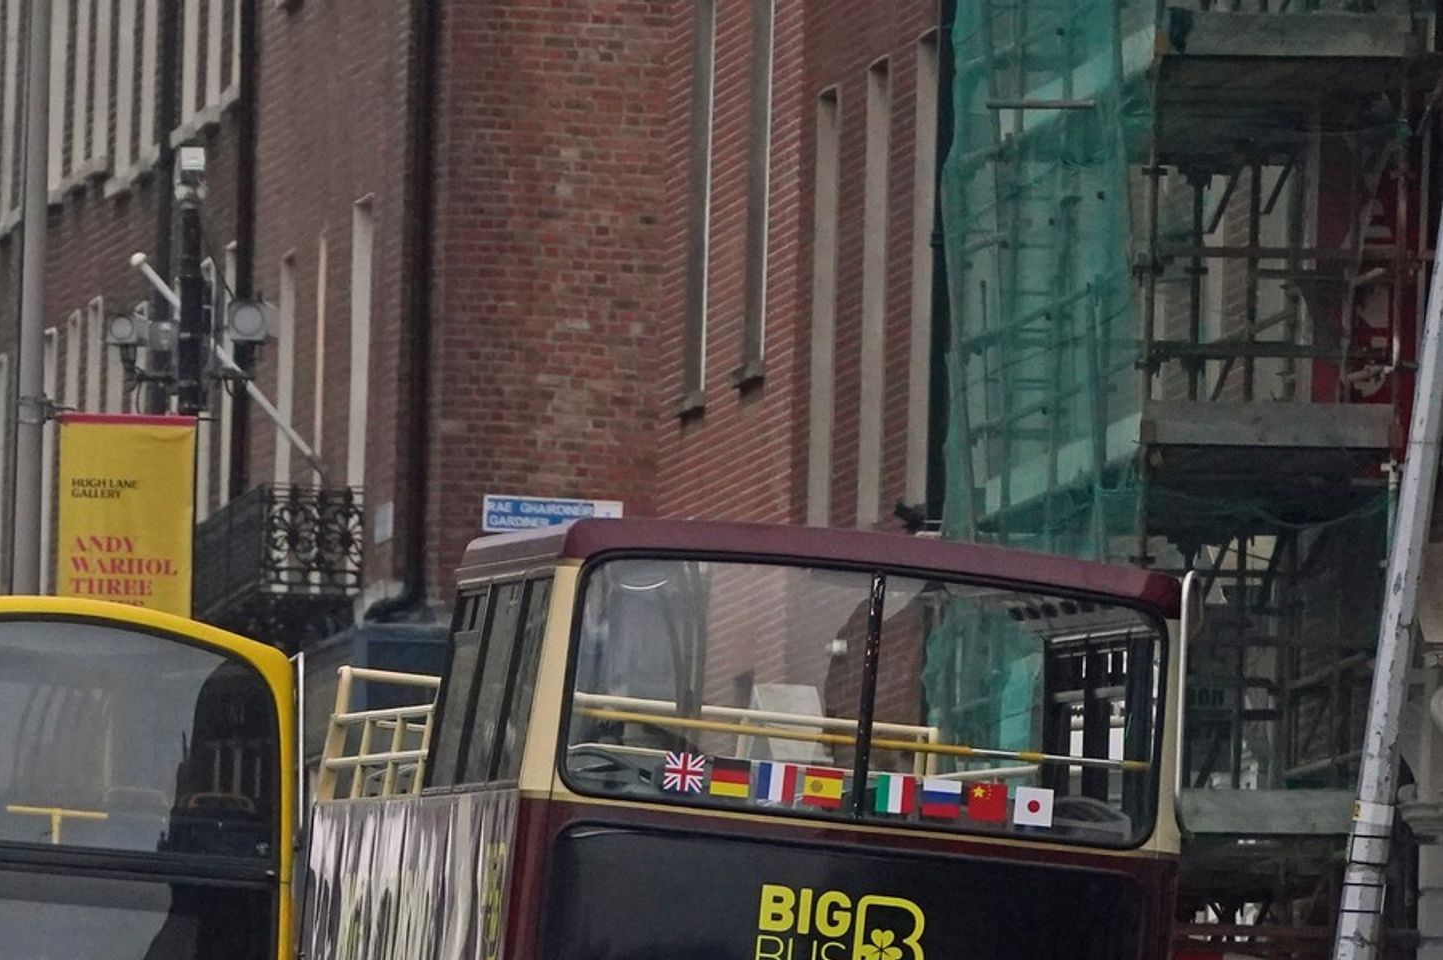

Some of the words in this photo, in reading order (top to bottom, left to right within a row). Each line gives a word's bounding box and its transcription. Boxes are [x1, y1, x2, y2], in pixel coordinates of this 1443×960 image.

[71, 478, 107, 488] HUGH
[109, 479, 138, 489] LANE
[71, 488, 122, 499] GALLERY
[489, 514, 550, 528] GARDINER
[73, 535, 138, 553] ANDY
[70, 556, 178, 576] WARHOL
[70, 577, 153, 597] THREE
[759, 884, 852, 938] BIG
